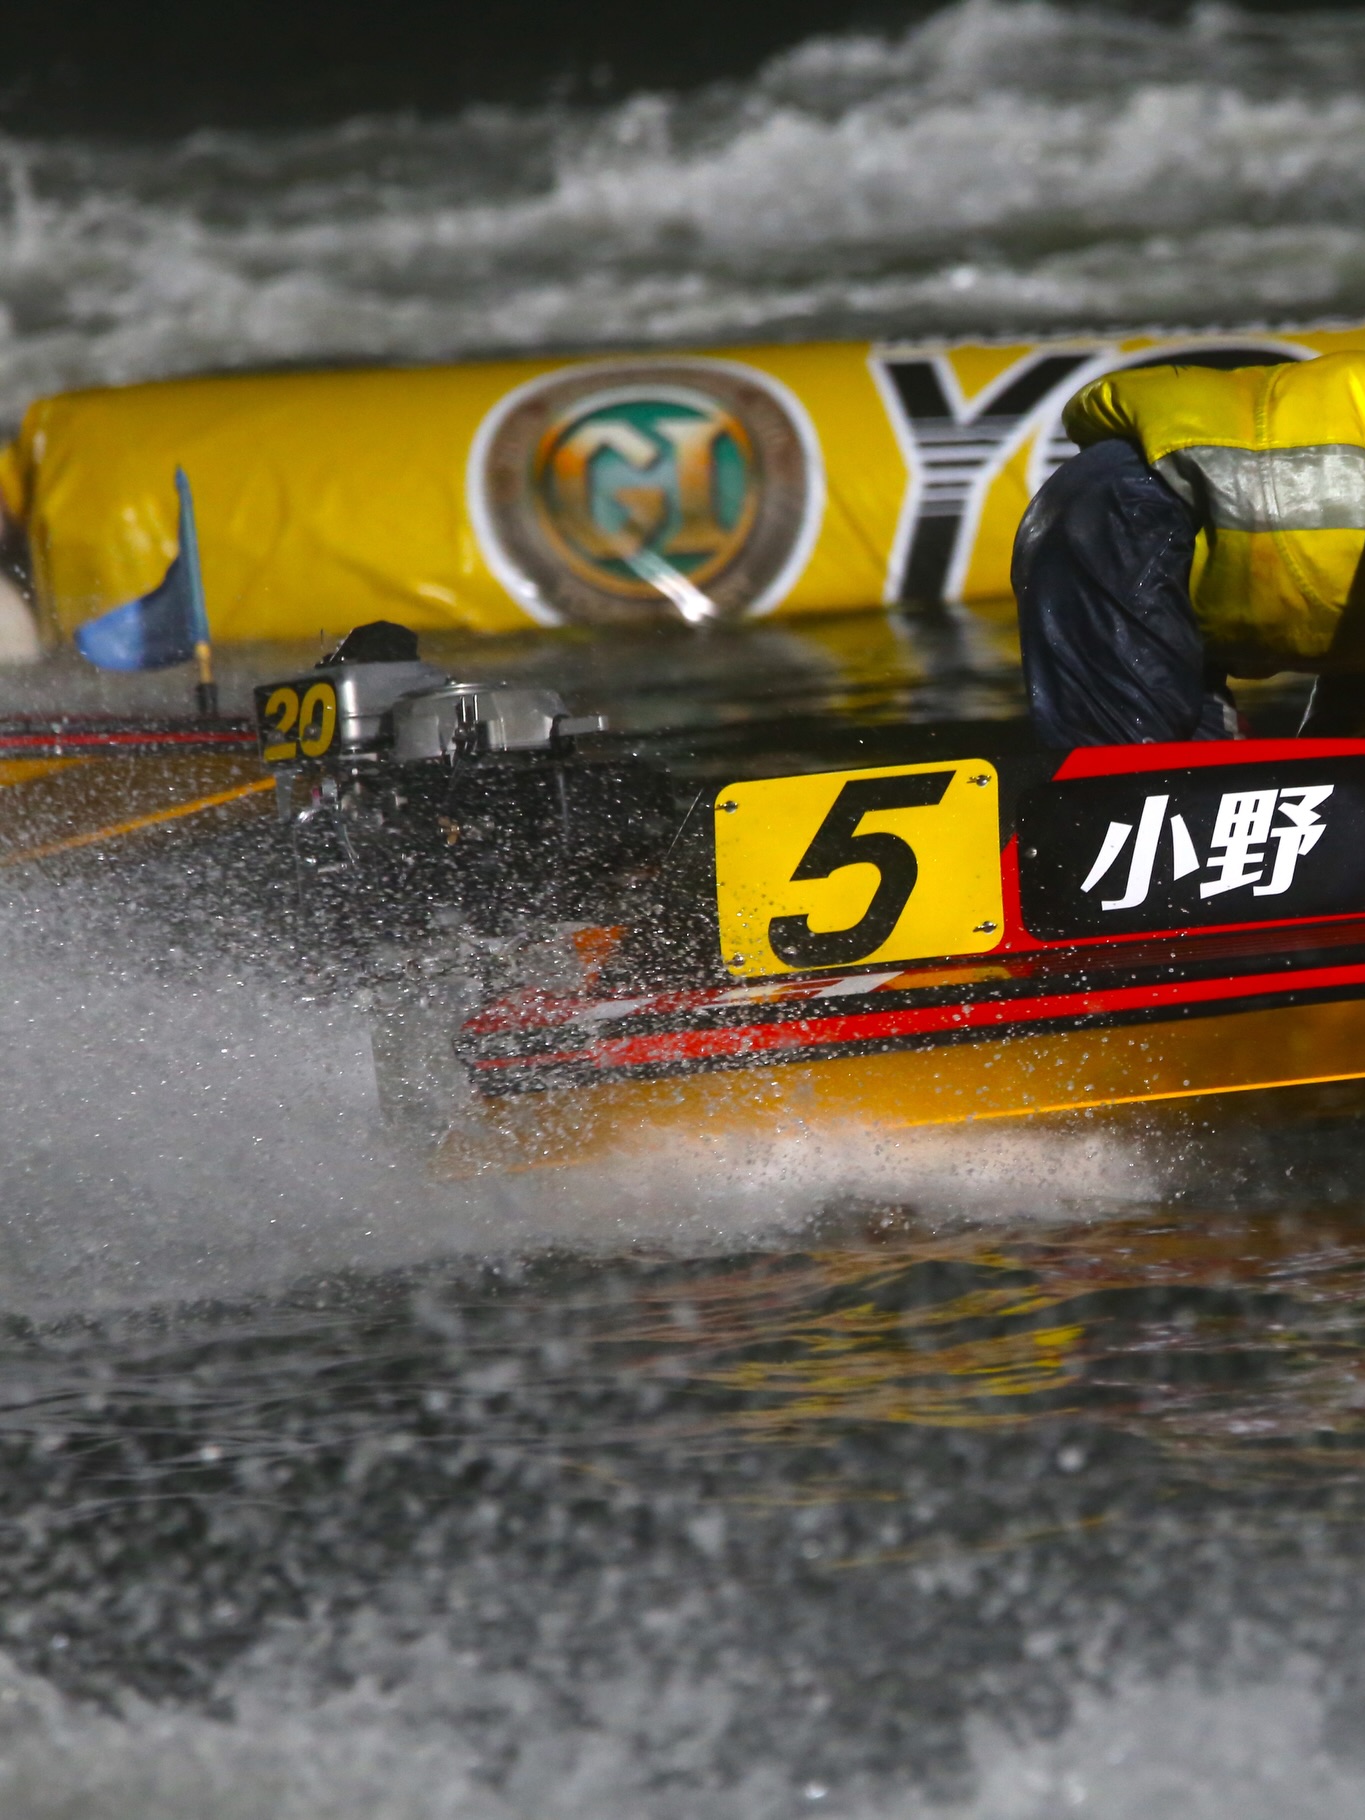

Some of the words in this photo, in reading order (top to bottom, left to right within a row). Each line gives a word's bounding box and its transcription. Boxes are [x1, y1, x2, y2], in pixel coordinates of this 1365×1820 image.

[263, 682, 337, 763] 20
[768, 770, 957, 968] 5
[1080, 784, 1335, 911] 小野
